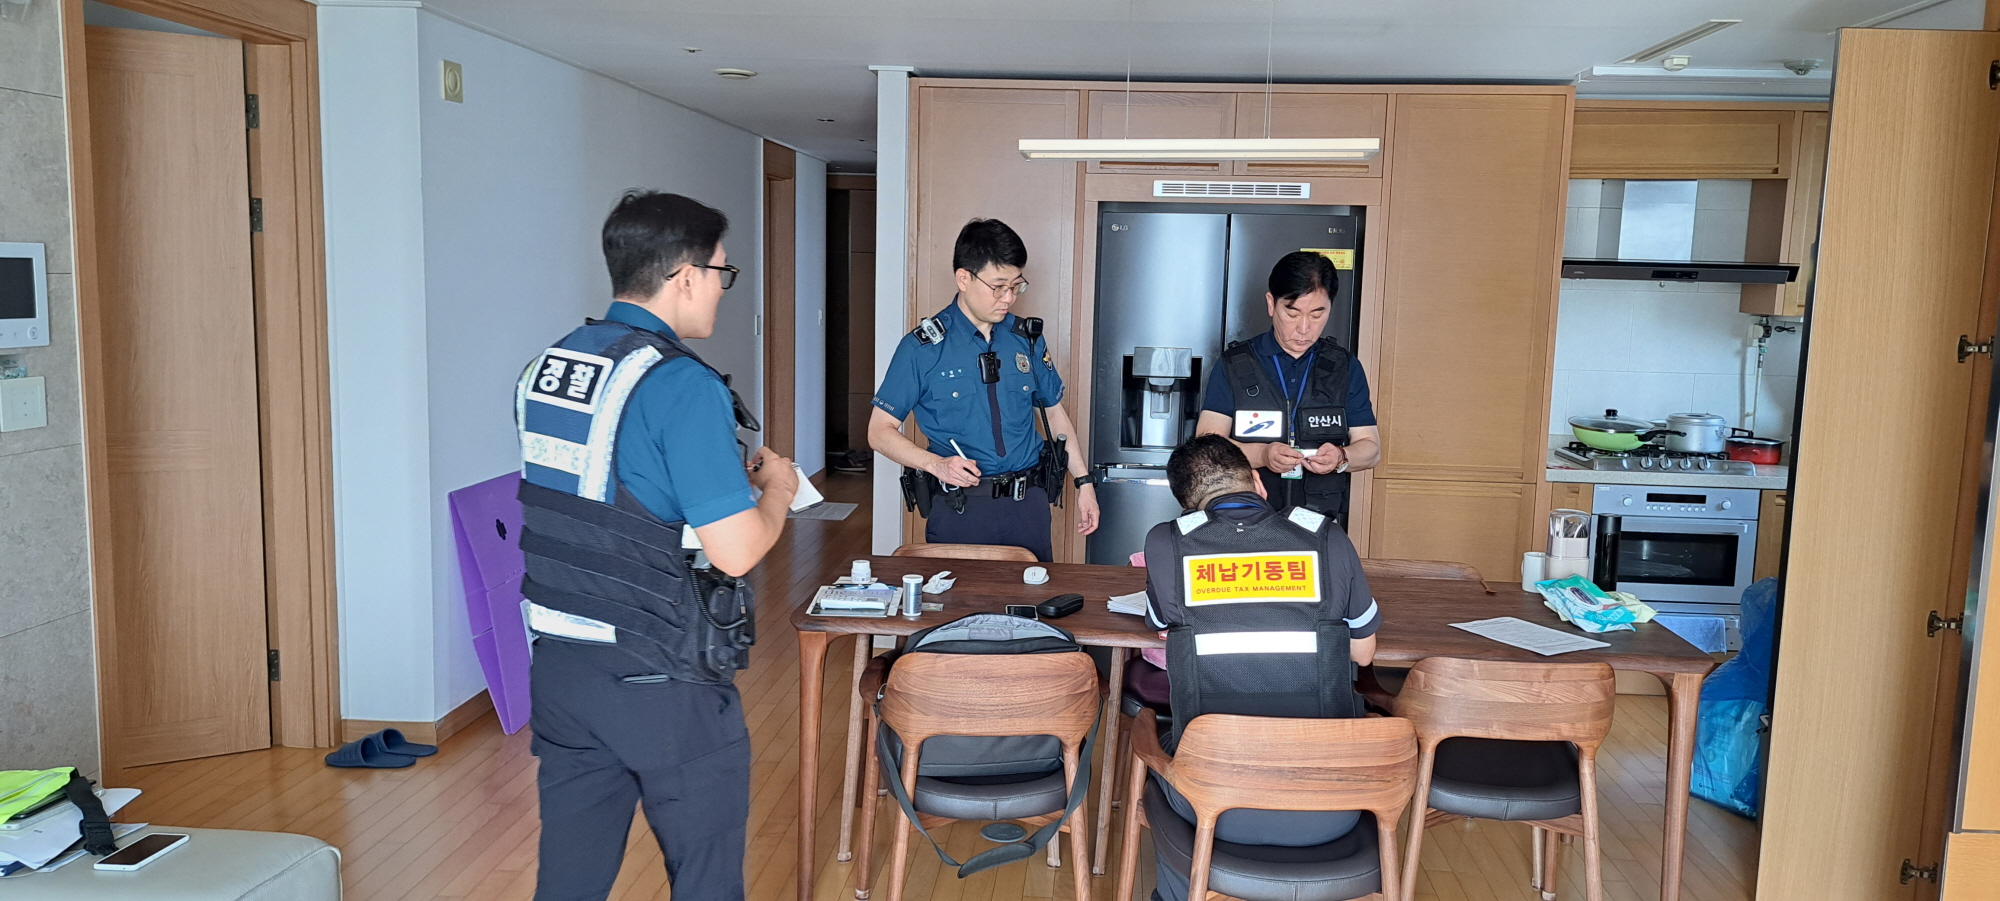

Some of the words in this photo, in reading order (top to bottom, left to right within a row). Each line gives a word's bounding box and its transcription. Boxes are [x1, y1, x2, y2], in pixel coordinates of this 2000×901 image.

[538, 358, 596, 400] 경찰
[1308, 415, 1342, 428] 안산시
[1196, 560, 1306, 583] 체납기동팀
[1196, 586, 1231, 595] OVERDUE
